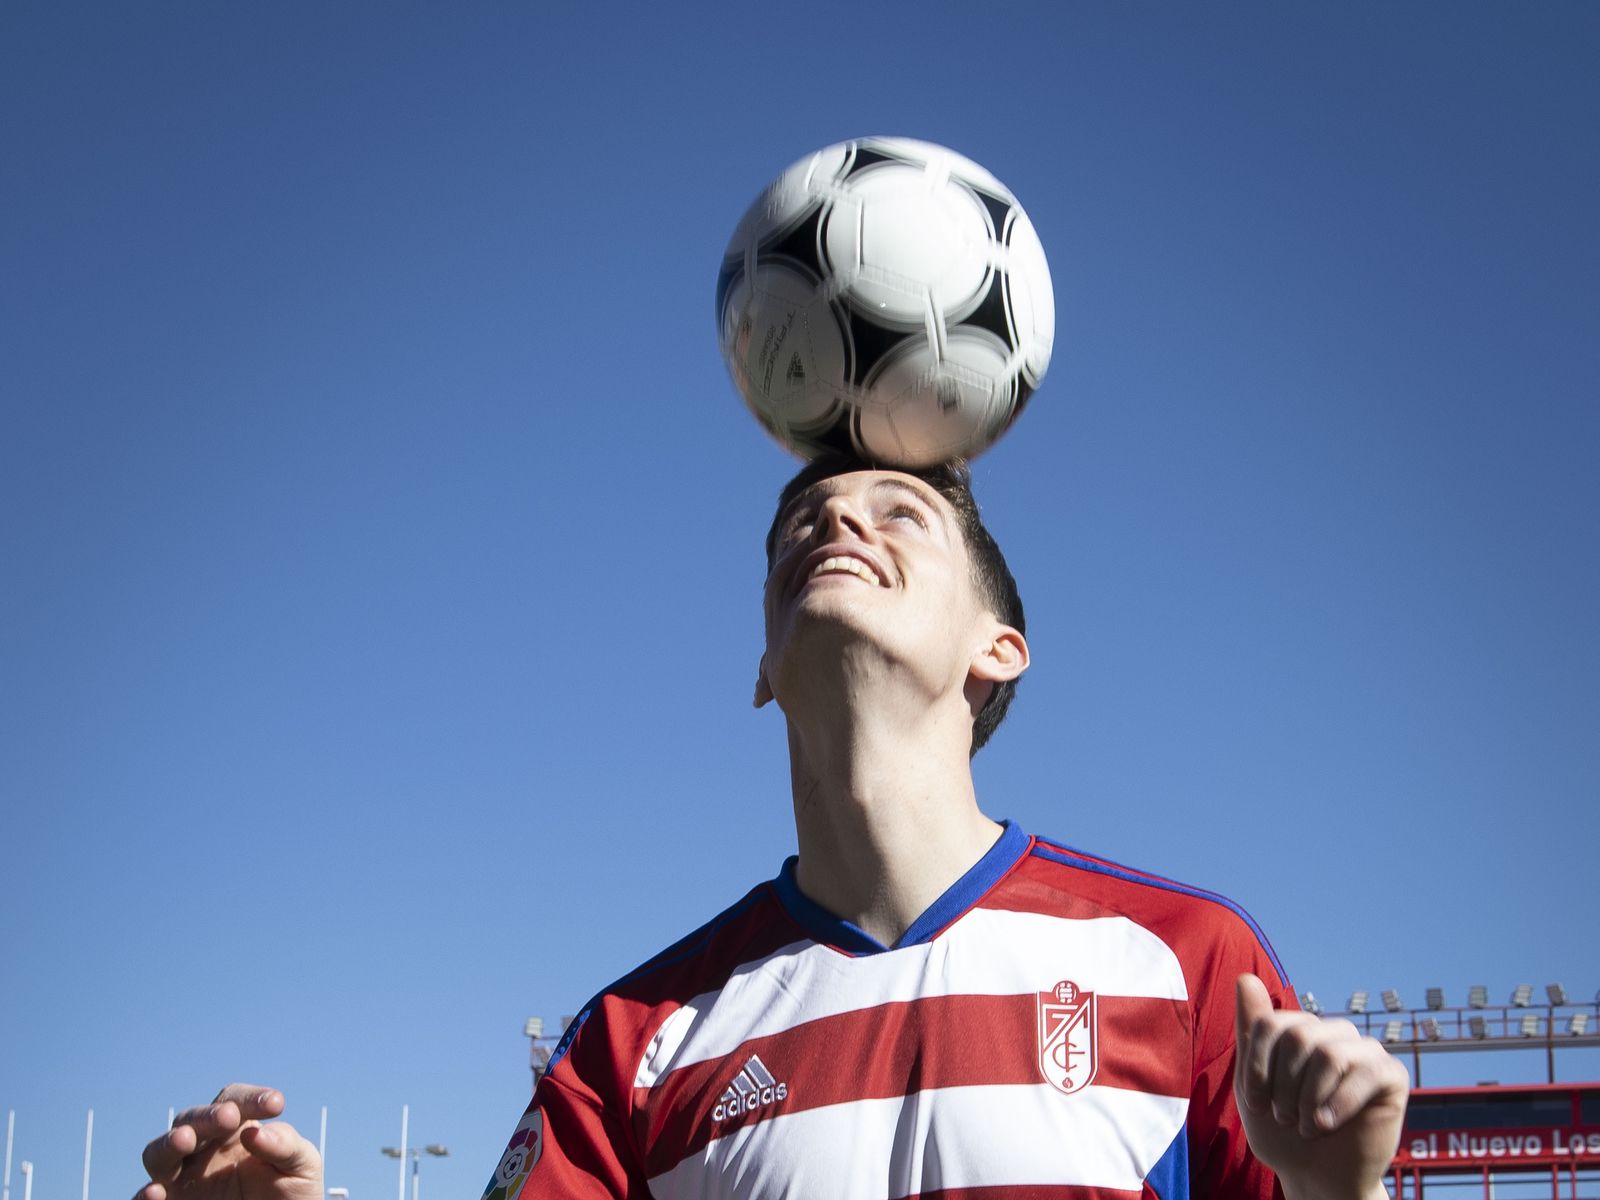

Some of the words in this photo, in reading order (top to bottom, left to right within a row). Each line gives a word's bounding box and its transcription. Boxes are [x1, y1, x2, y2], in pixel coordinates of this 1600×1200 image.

[712, 1083, 788, 1121] adidas
[1410, 1134, 1438, 1159] al
[1448, 1132, 1542, 1157] Nuevo
[1552, 1129, 1600, 1155] Los
